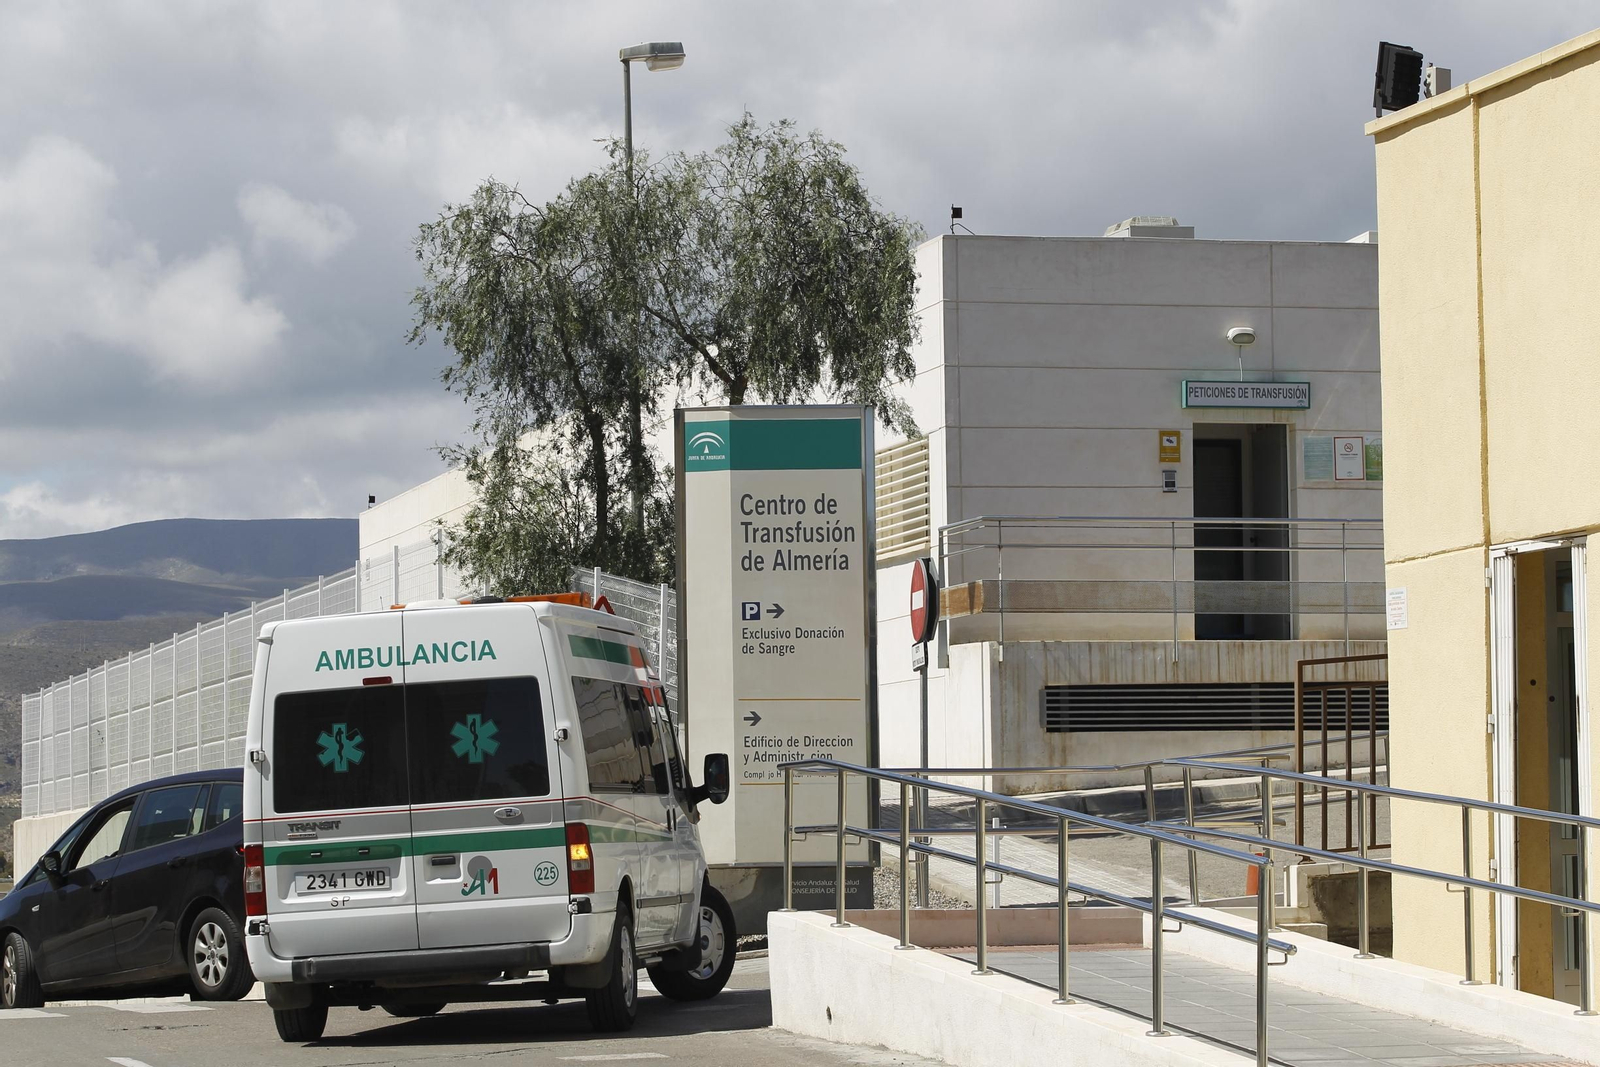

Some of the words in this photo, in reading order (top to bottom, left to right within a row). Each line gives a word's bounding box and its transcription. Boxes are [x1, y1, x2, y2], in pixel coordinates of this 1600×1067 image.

[1188, 386, 1236, 398] PETICIONES
[1238, 387, 1249, 398] DE
[1251, 385, 1307, 399] TRANSFUSIÓN
[740, 493, 806, 516] Centro
[814, 493, 838, 515] de
[740, 520, 855, 543] Transfusión
[741, 549, 765, 572] de
[772, 547, 849, 571] Almería
[745, 603, 758, 620] P
[742, 627, 791, 640] Exclusivo
[795, 626, 845, 639] Donación
[315, 639, 497, 672] AMBULANCIA
[742, 643, 754, 654] de
[758, 642, 796, 657] Sangre
[743, 736, 783, 748] Edificio
[786, 736, 799, 748] de
[803, 735, 853, 748] Direccion
[743, 753, 749, 766] y
[753, 750, 833, 763] Administrcion
[743, 770, 775, 780] Compljo
[287, 820, 342, 832] TRANSIT
[306, 872, 346, 890] 2341
[354, 870, 386, 887] GWD
[536, 866, 556, 881] 225
[791, 886, 825, 894] ONSEJERÍA
